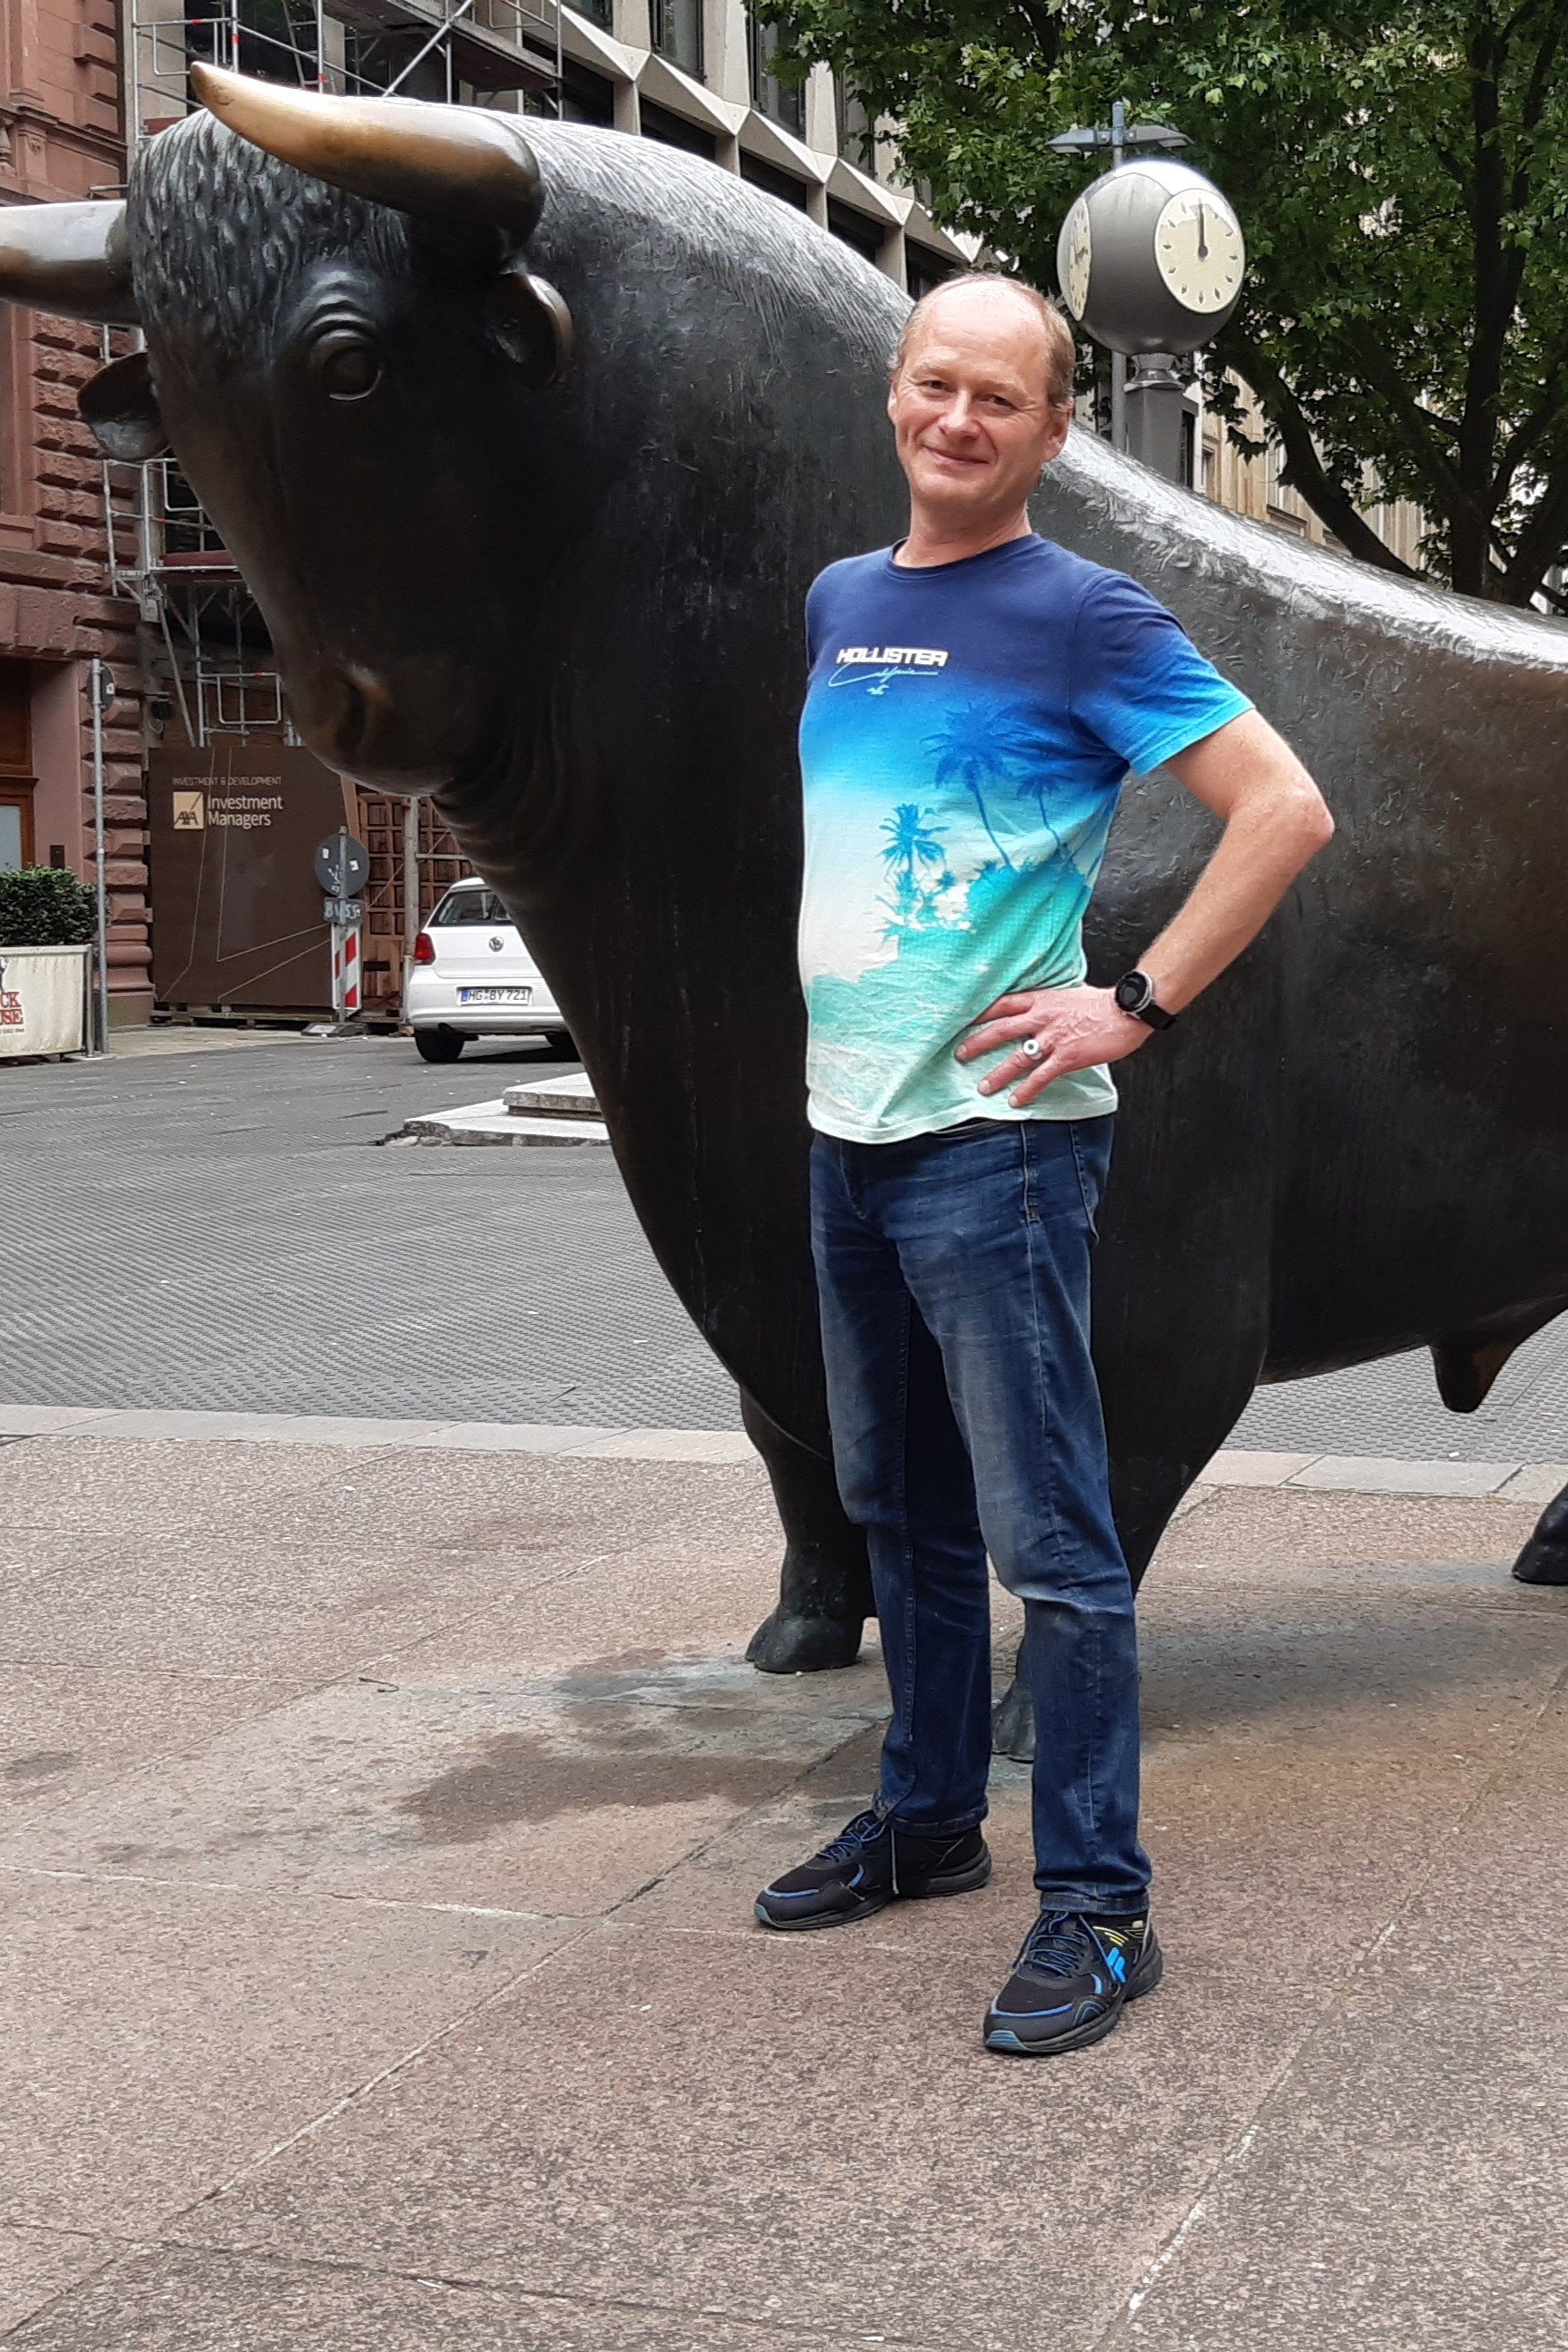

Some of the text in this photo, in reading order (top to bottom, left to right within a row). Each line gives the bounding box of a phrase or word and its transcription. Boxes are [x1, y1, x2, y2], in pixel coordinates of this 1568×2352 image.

[836, 647, 949, 667] HOLLISTER
[172, 776, 219, 786] INVESTMENT
[228, 776, 282, 786] DEVELOPMENT
[208, 795, 283, 809] Investment
[174, 810, 199, 826] AXA
[208, 811, 271, 829] Managers
[469, 989, 526, 1000] HG BY 721
